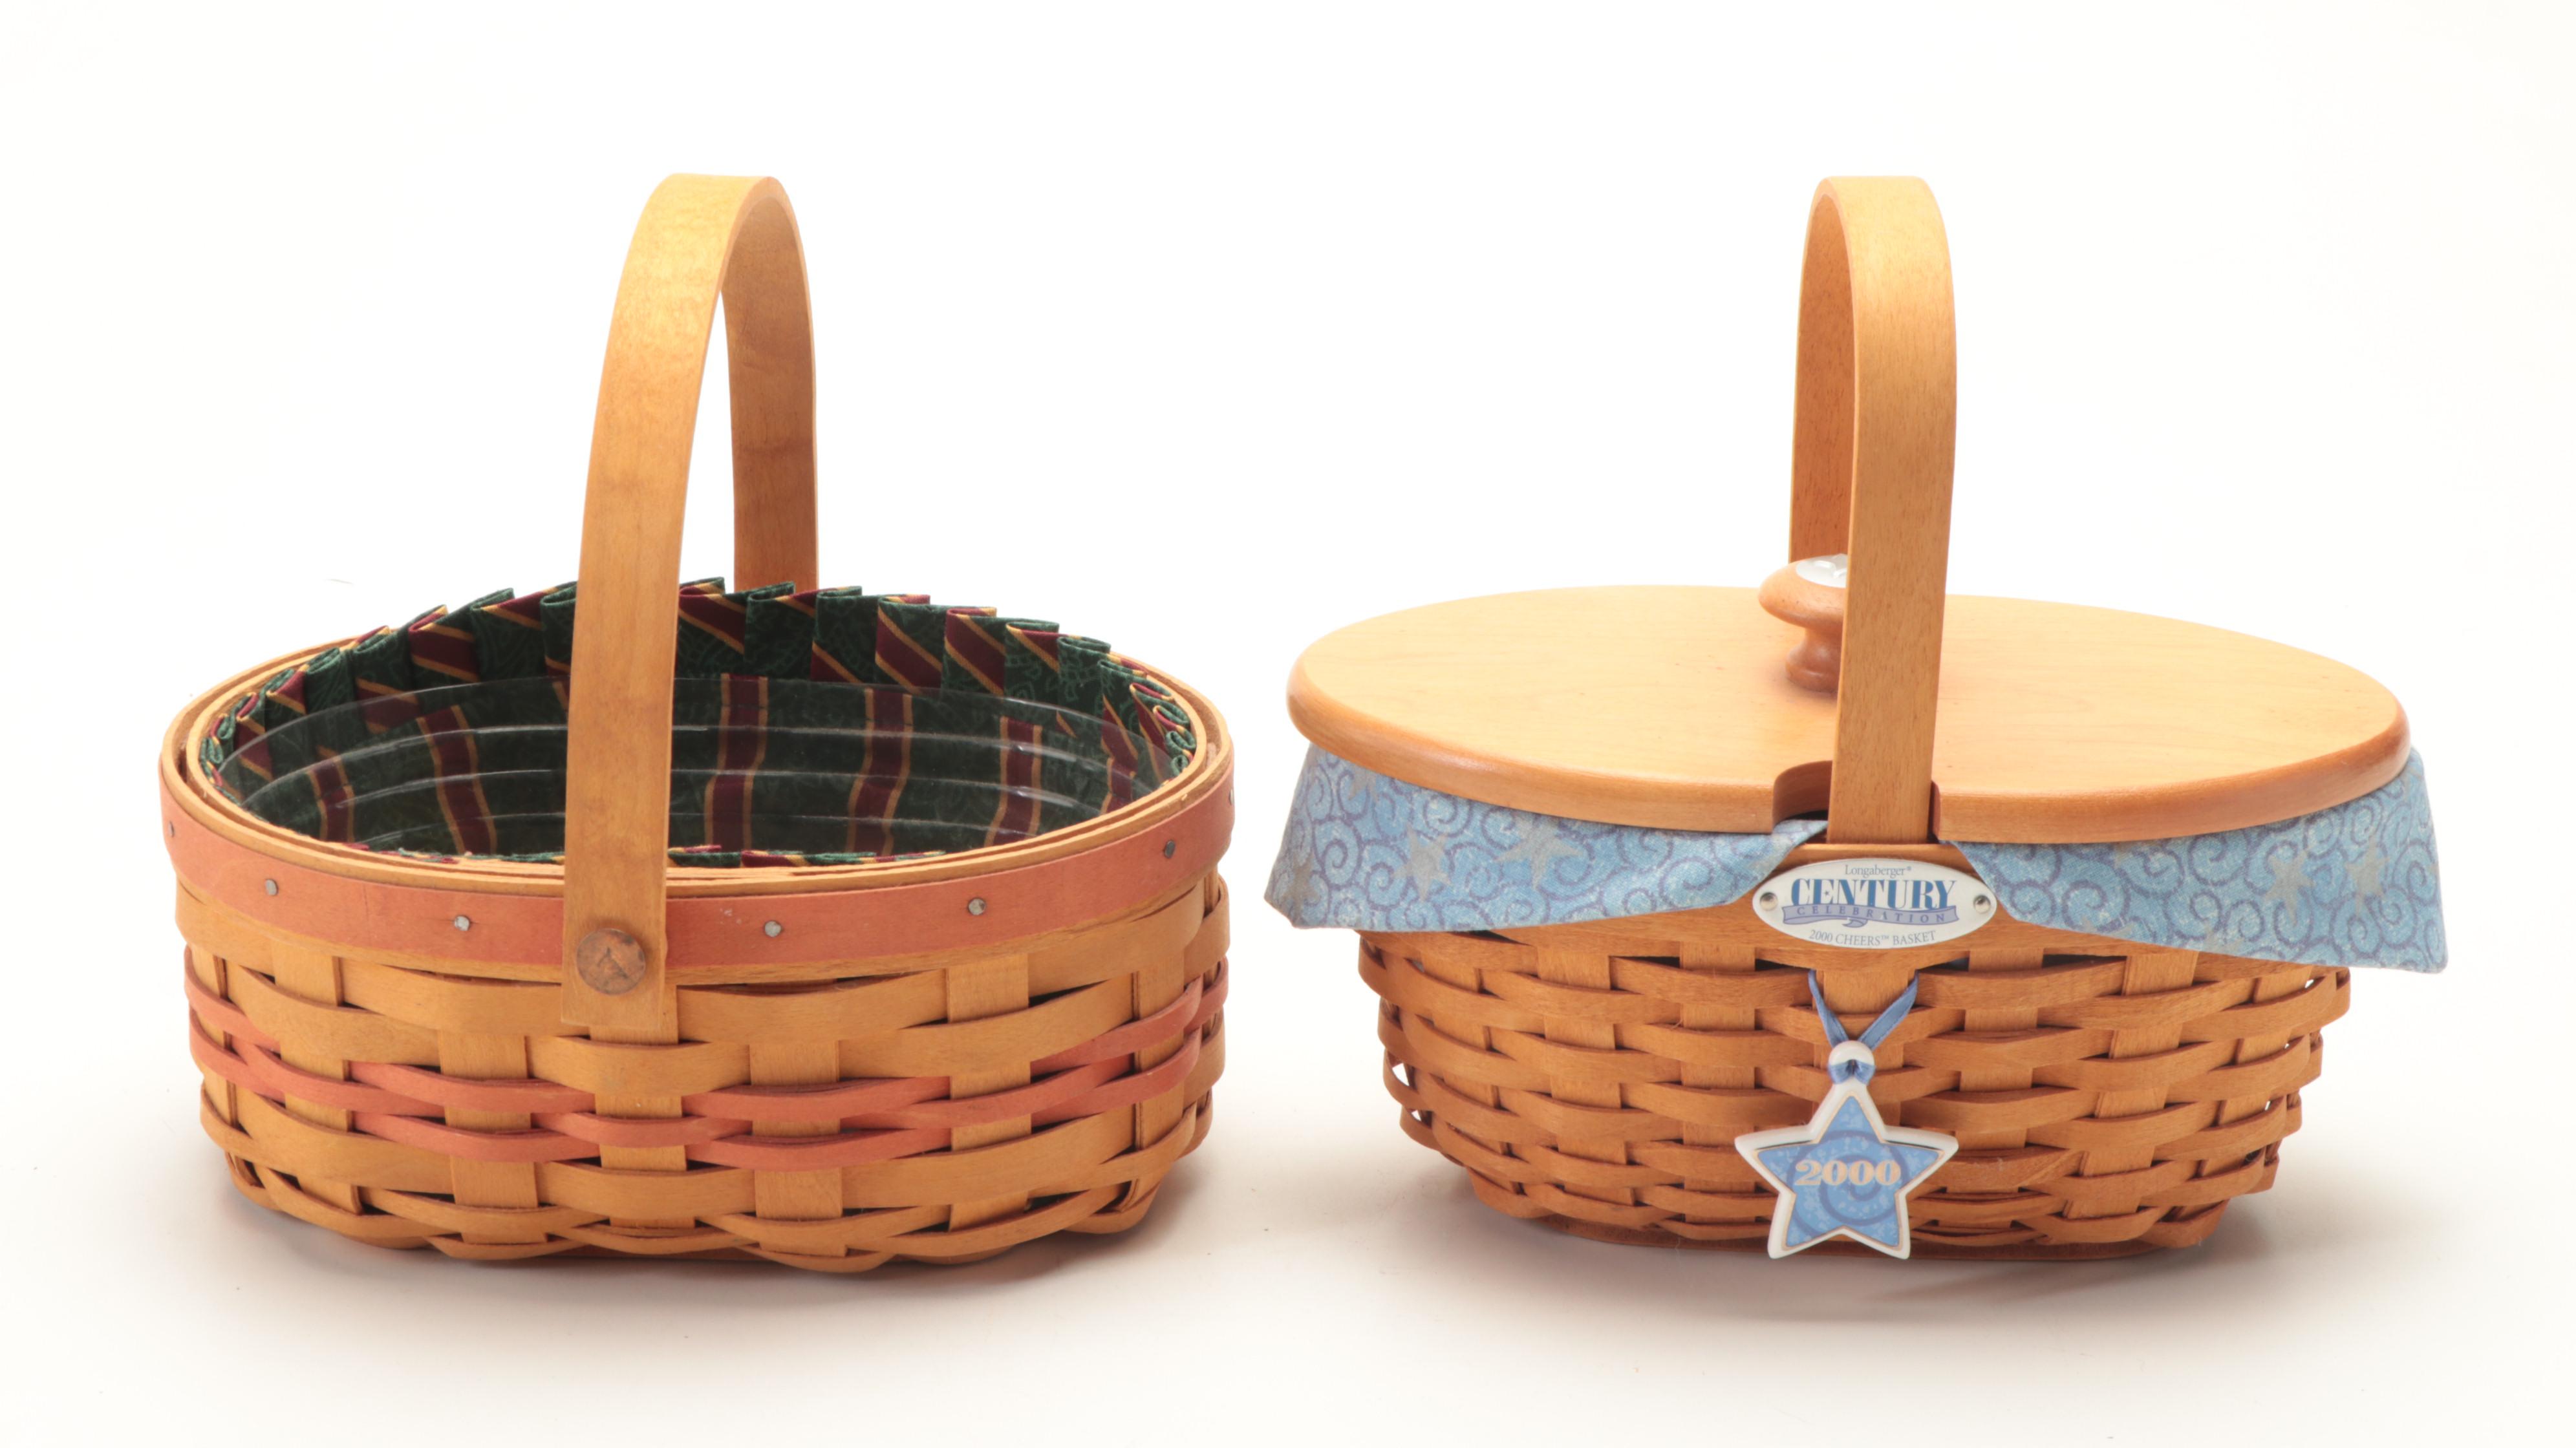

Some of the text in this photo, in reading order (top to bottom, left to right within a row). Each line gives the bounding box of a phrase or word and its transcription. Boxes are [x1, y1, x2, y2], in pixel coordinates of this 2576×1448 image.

[1790, 878, 1957, 911] CENTURY
[1796, 906, 1945, 923] CELEBRATION
[1809, 929, 1833, 942] 2000
[1892, 930, 1937, 946] BASKET
[1794, 1160, 1901, 1186] 2000
